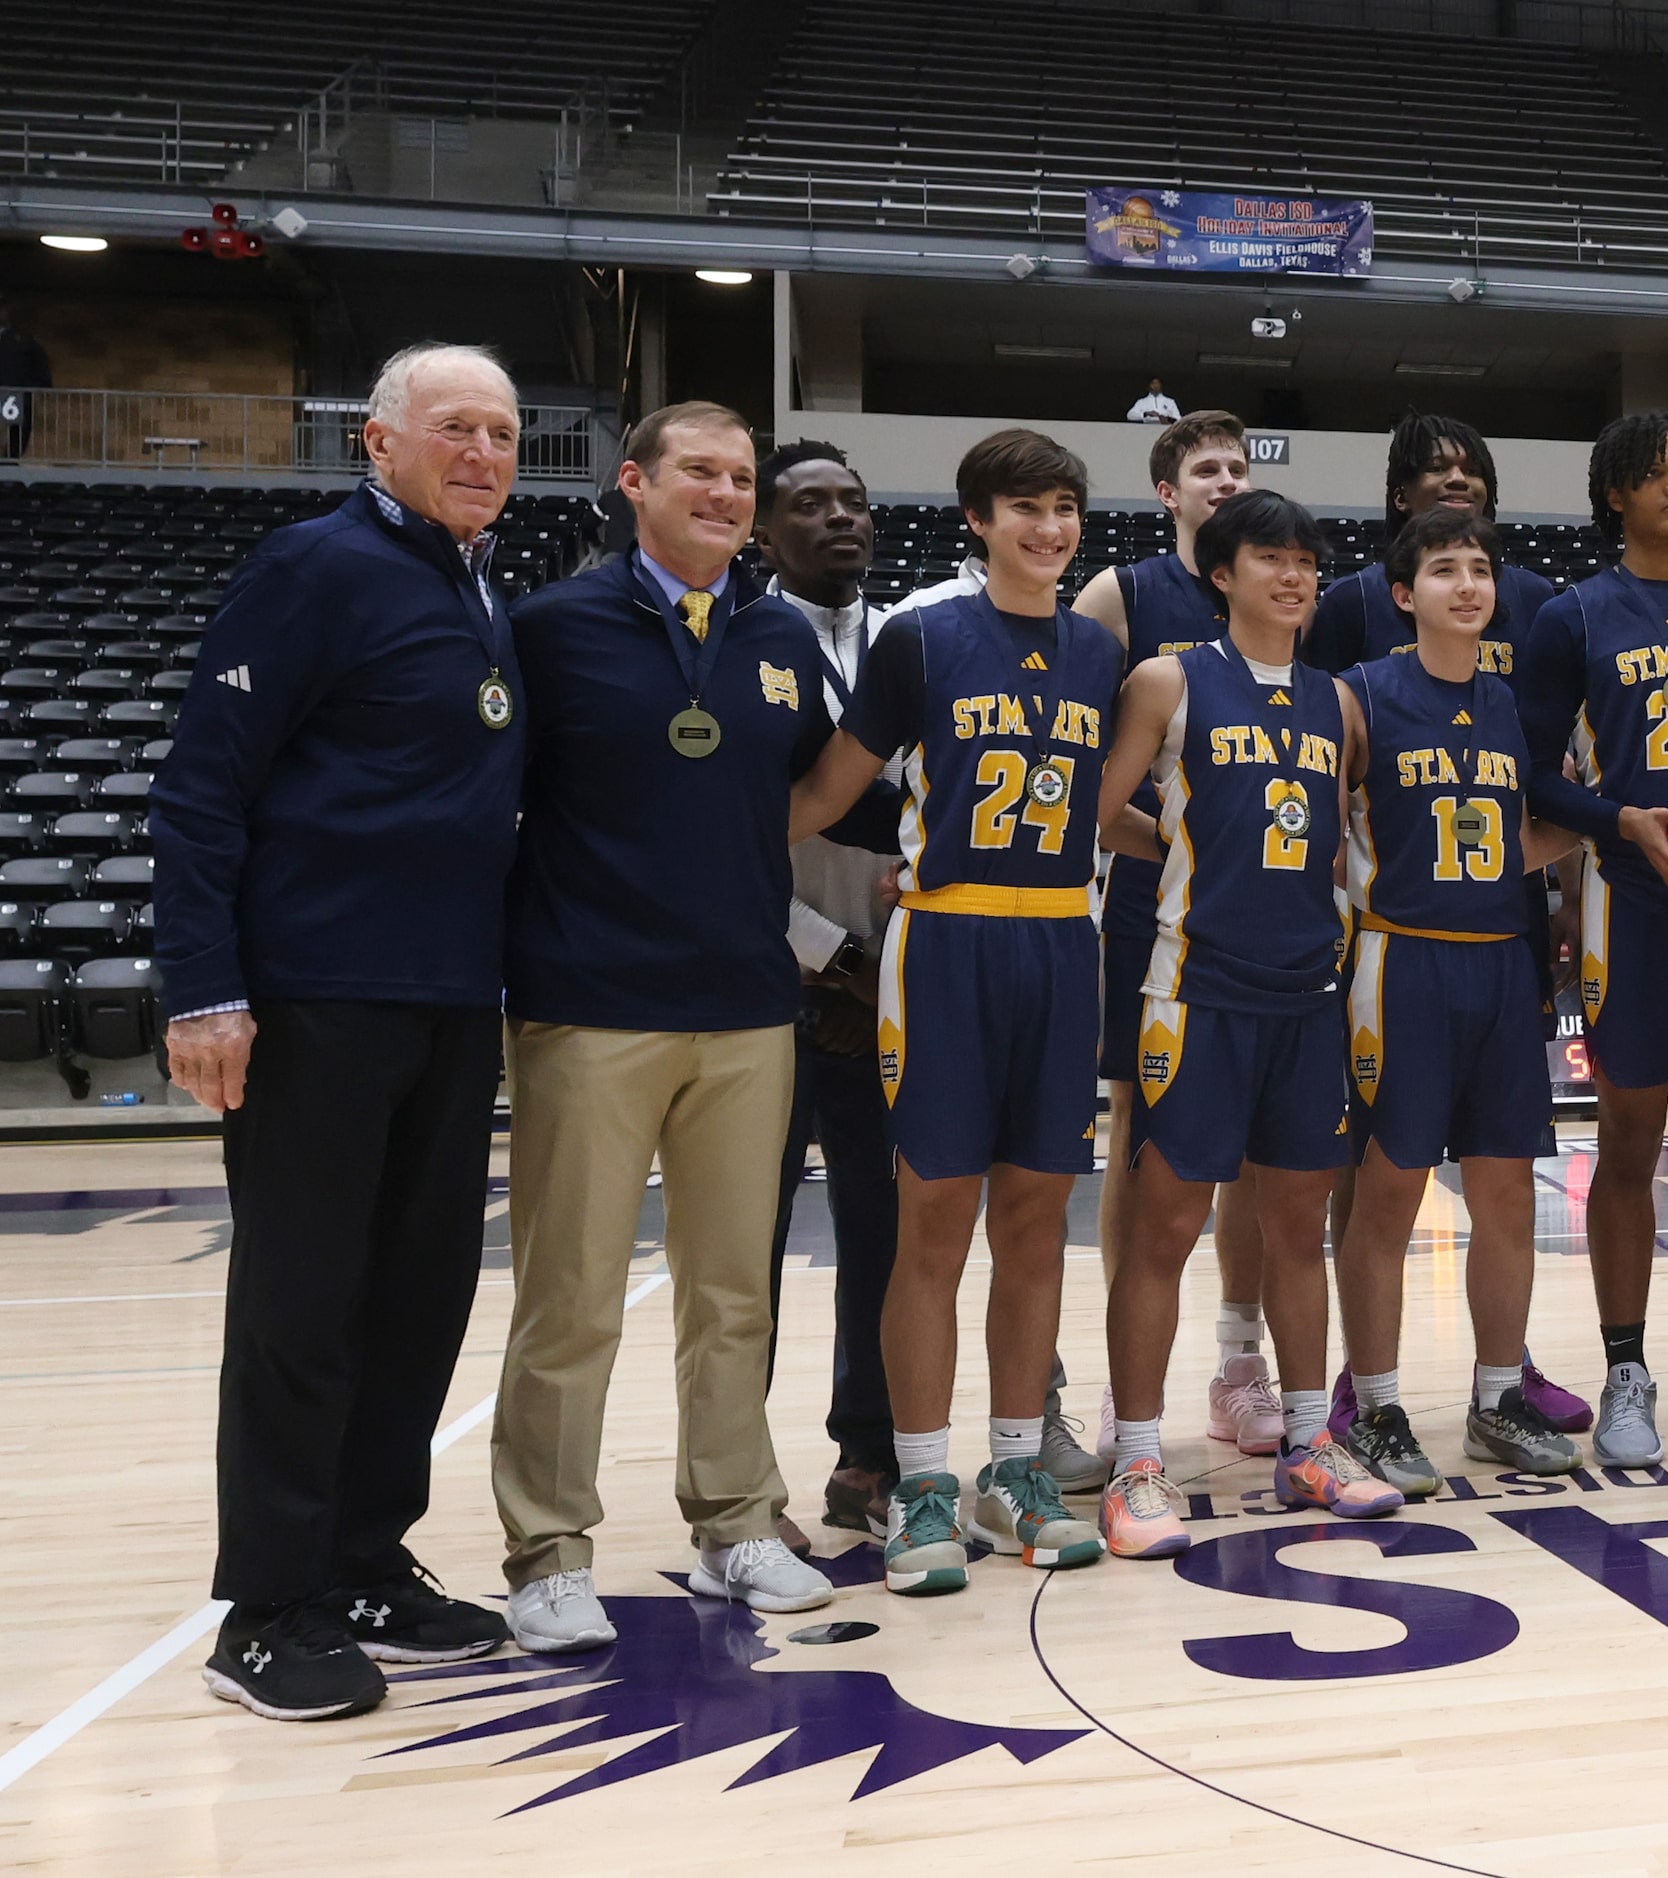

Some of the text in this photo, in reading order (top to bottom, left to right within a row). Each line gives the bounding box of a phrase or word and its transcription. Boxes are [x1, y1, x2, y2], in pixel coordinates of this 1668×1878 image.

[1197, 216, 1349, 238] HOLIDAY INVITATIONAL
[1234, 198, 1313, 221] DALLAS ISD
[1209, 240, 1337, 257] ELLIS DAVIS FIELDHOUSE
[0, 395, 20, 420] 6
[1249, 438, 1285, 460] 107
[952, 693, 1100, 749] ST.MRK'S
[1210, 726, 1339, 778] ST.MRK'S
[1397, 747, 1520, 792] ST.MRK'S
[970, 749, 1076, 856] 24
[1262, 778, 1310, 872] 2
[1430, 796, 1505, 882] 13
